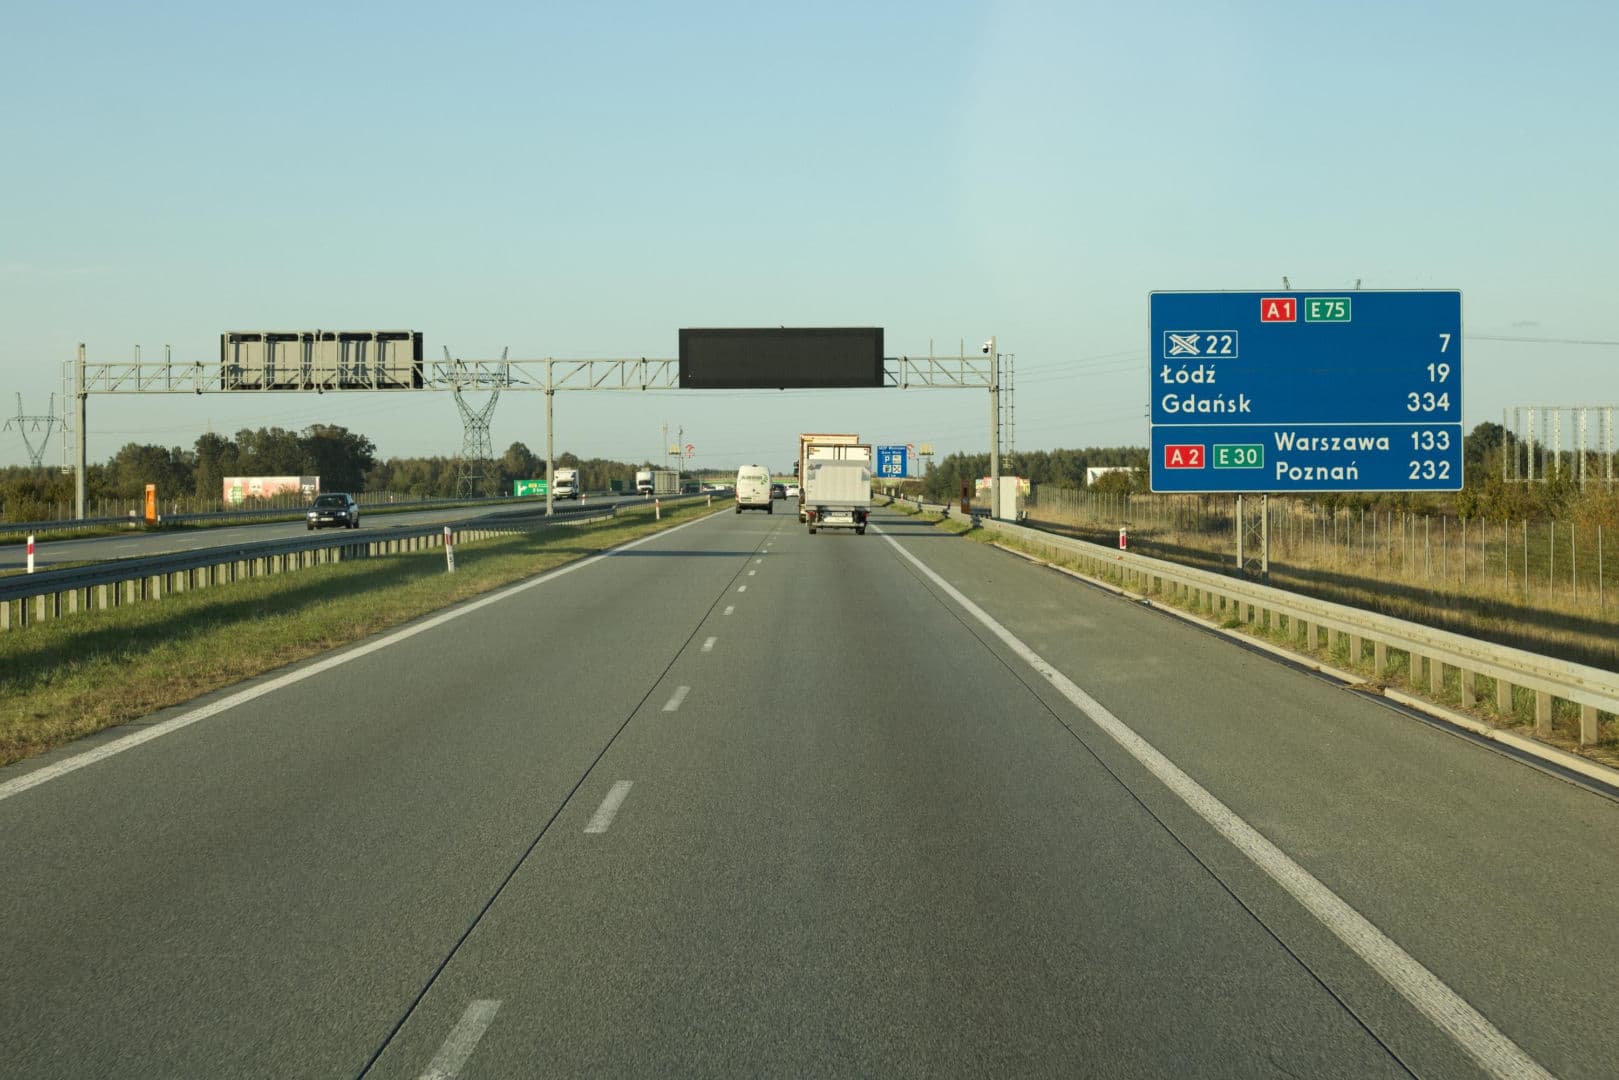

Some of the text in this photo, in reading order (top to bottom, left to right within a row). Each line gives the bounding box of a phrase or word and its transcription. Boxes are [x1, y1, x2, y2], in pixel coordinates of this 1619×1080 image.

[1206, 335, 1232, 354] 22
[1439, 333, 1451, 353] 7
[1160, 364, 1216, 384] Łódź
[1427, 363, 1450, 383] 19
[1161, 393, 1251, 413] Gdańsk
[1407, 392, 1450, 412] 334
[1274, 431, 1390, 451] Warszawa
[1411, 431, 1450, 451] 133
[1276, 461, 1358, 480] Poznań
[1409, 460, 1450, 480] 232
